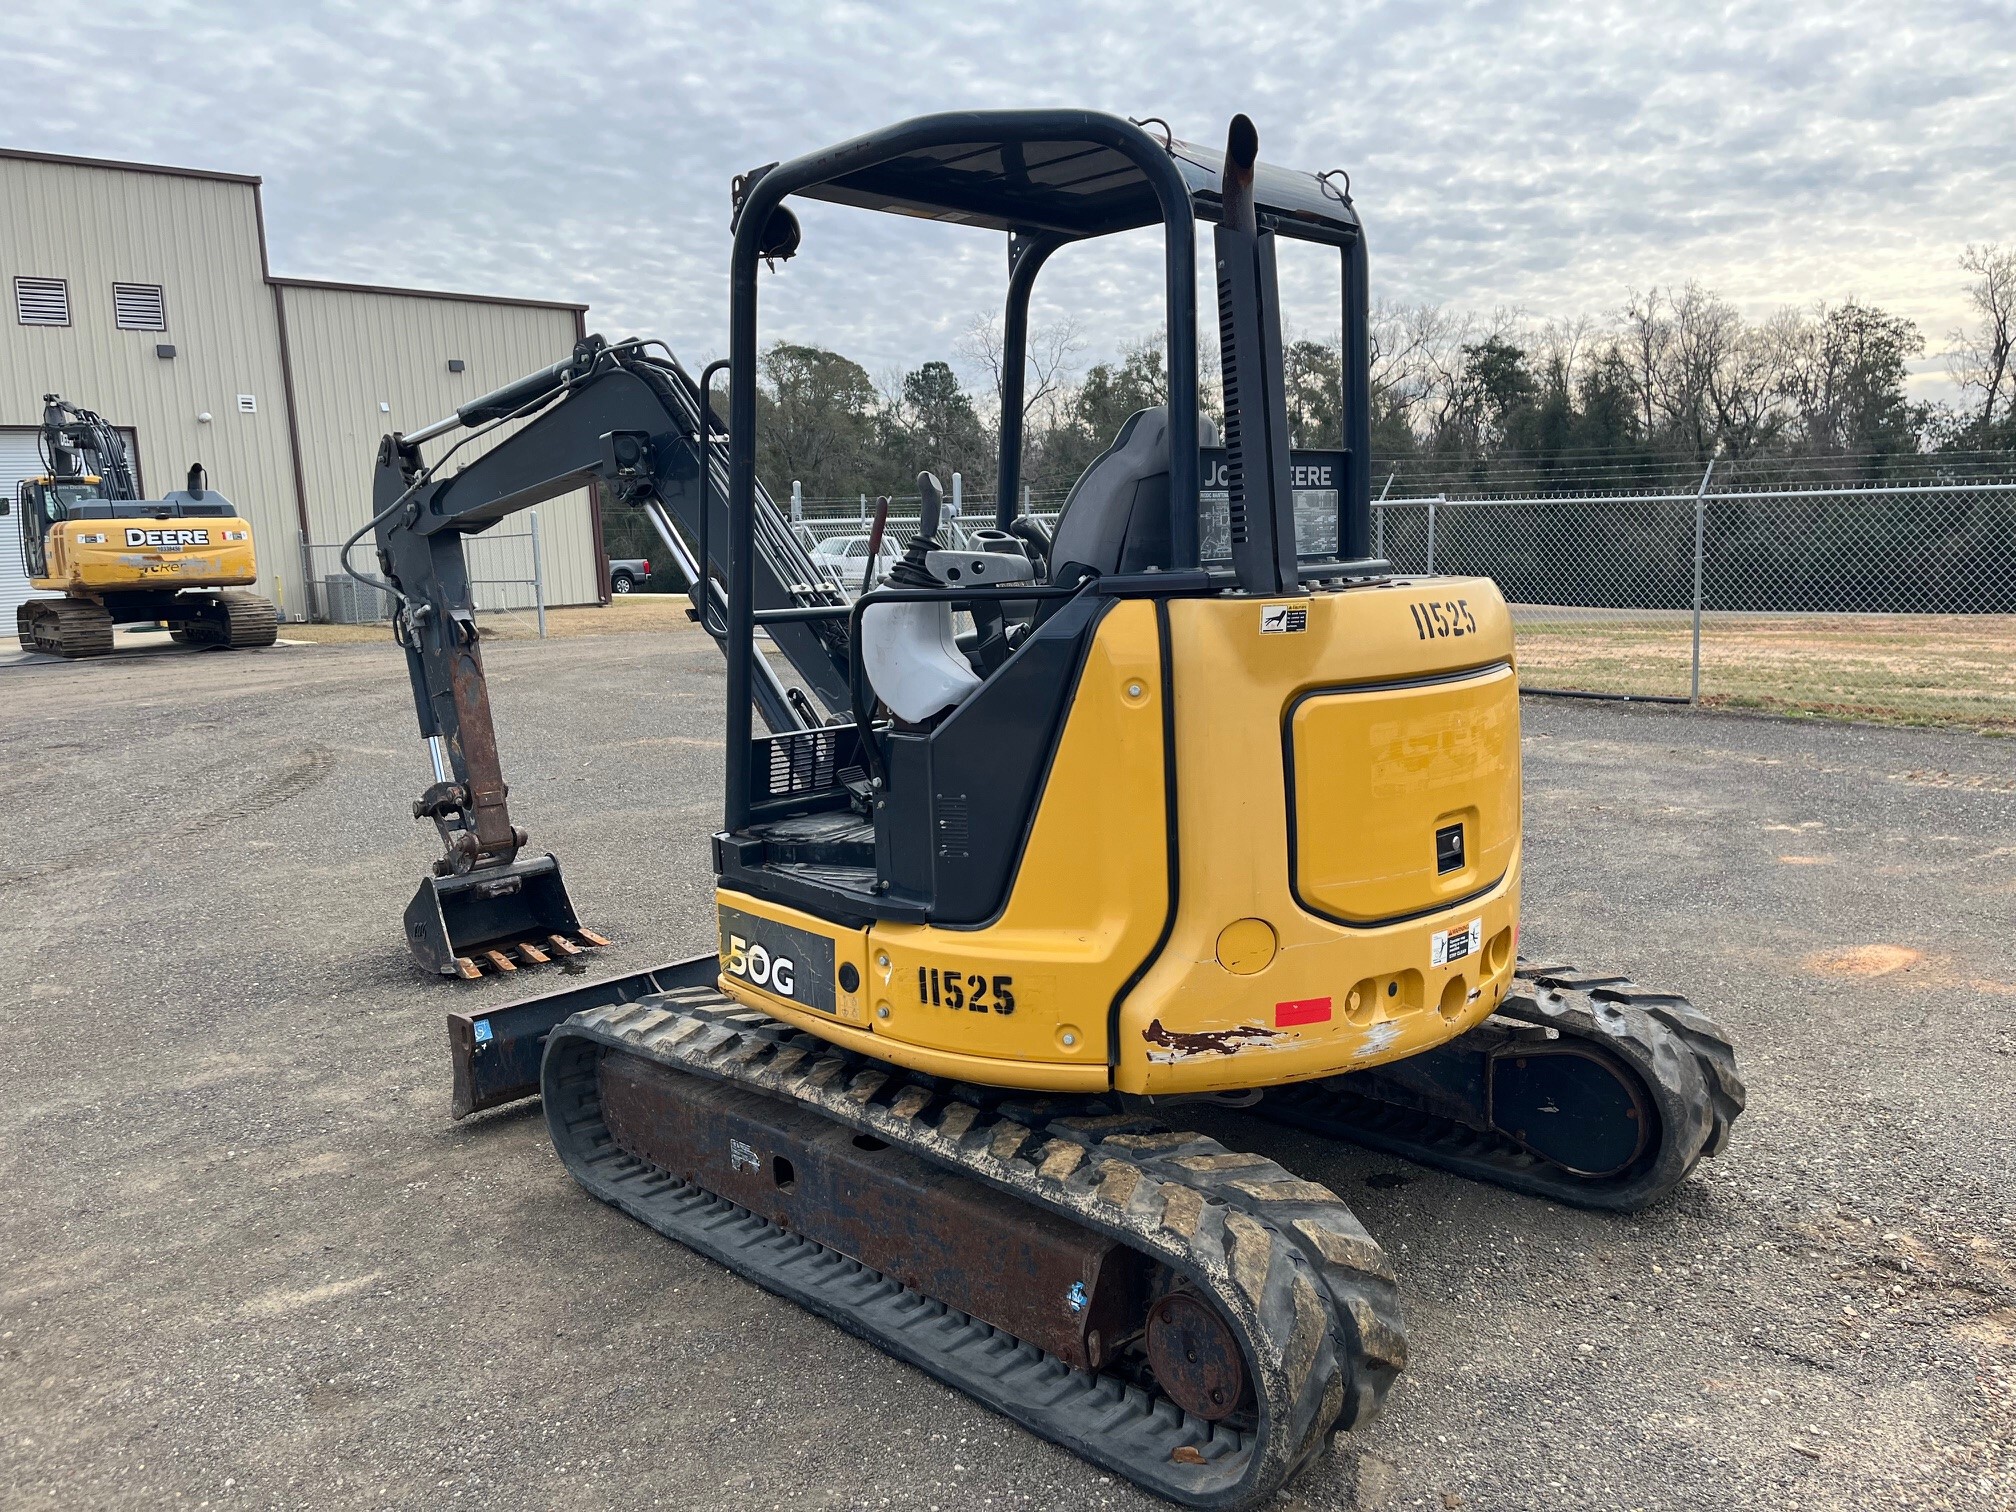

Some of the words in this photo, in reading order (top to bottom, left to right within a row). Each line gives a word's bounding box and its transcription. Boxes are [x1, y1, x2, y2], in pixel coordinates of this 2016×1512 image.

[1290, 466, 1332, 486] ERE
[125, 528, 209, 547] DEERE
[1410, 599, 1477, 640] 11525
[729, 934, 794, 996] 50G
[918, 966, 1015, 1016] 11525
